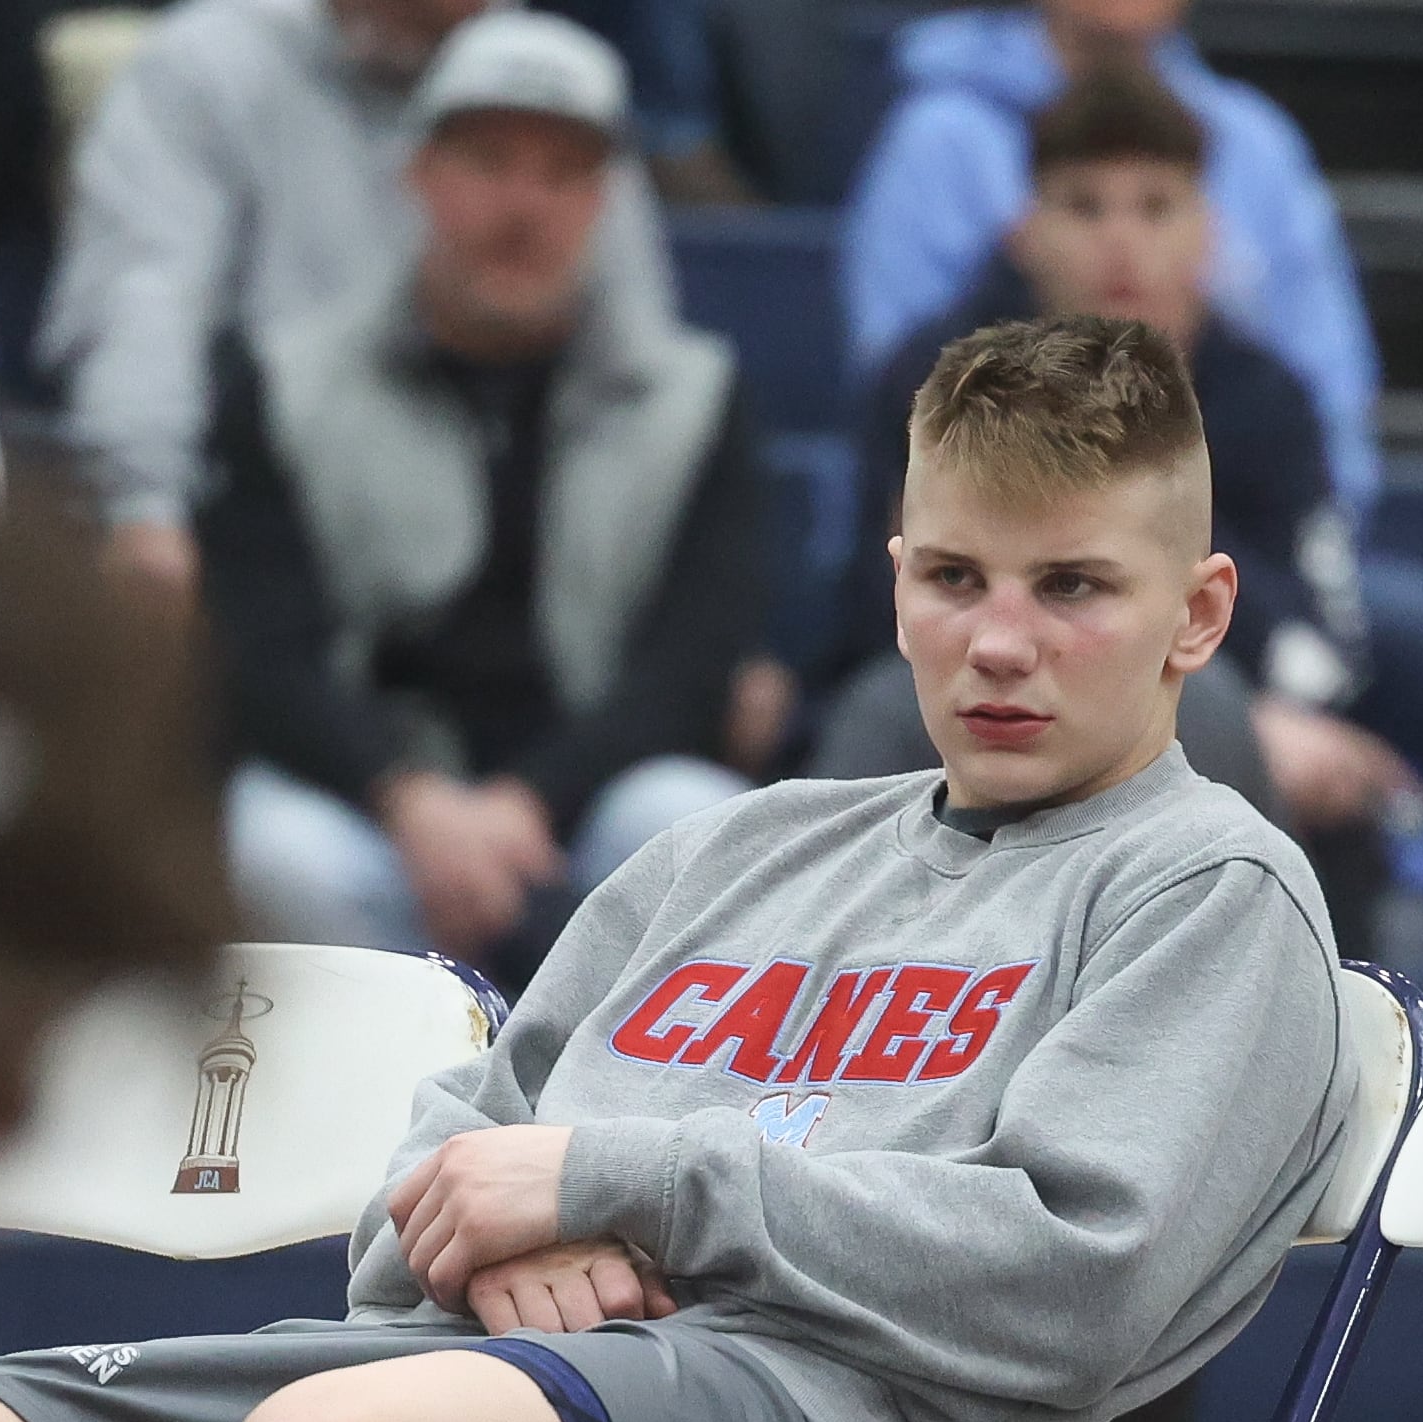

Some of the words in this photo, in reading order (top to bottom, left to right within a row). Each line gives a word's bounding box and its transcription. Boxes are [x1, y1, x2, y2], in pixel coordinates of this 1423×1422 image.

[607, 957, 1043, 1087] CANES
[750, 1091, 832, 1150] M
[194, 1169, 220, 1190] JCA
